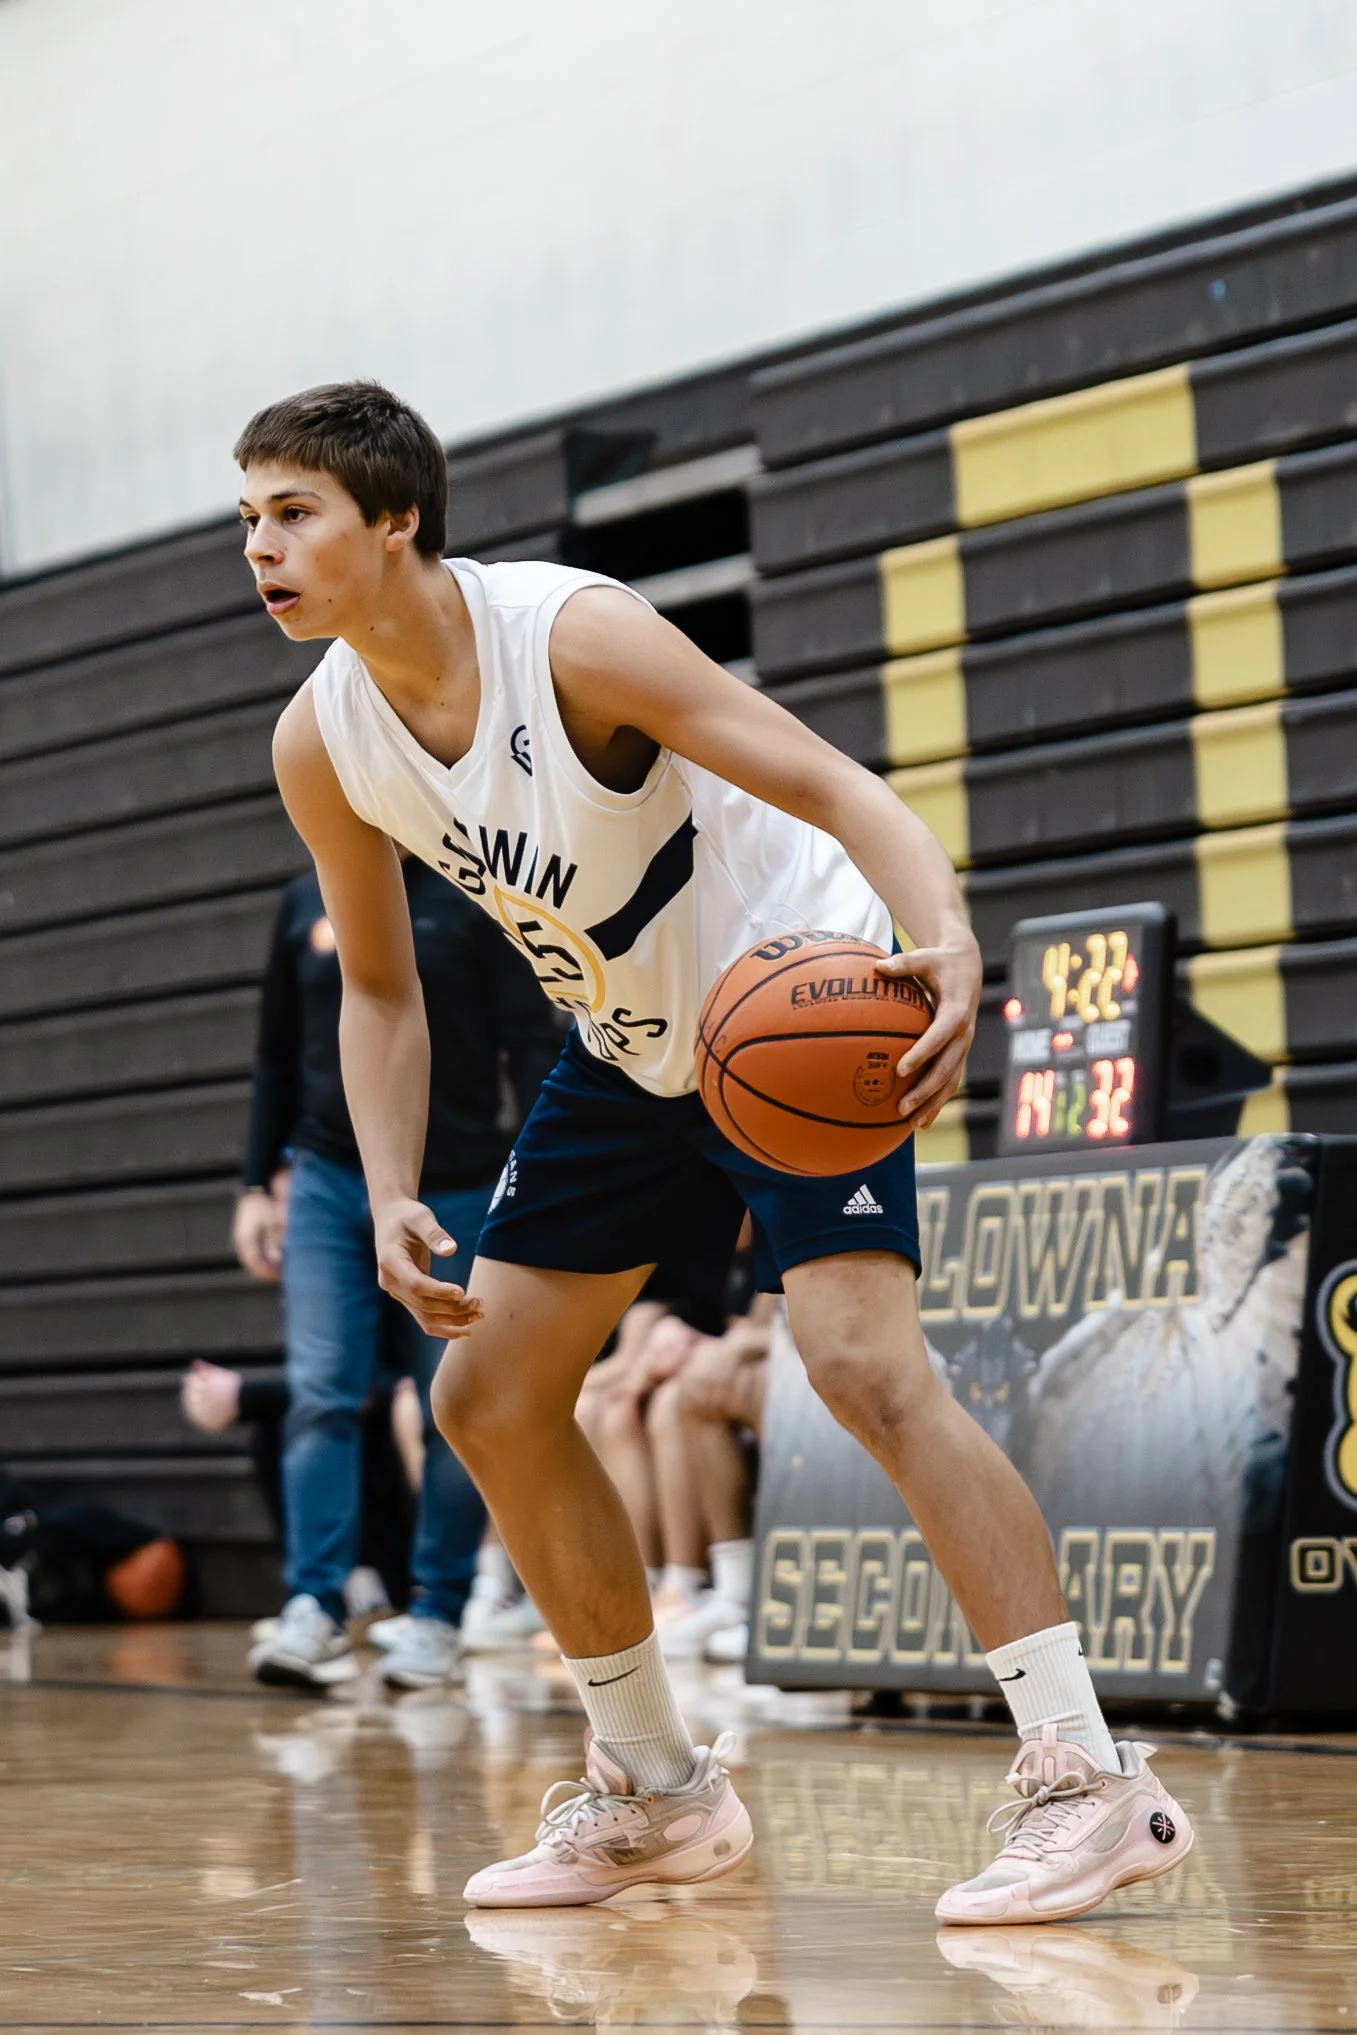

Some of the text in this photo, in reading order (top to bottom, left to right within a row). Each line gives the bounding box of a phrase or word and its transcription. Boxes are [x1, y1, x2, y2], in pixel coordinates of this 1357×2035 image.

[1042, 930, 1128, 1024] 4:22
[1086, 1057, 1135, 1140] 32
[843, 1203, 883, 1215] adidas
[918, 1164, 1209, 1320] LOWNA
